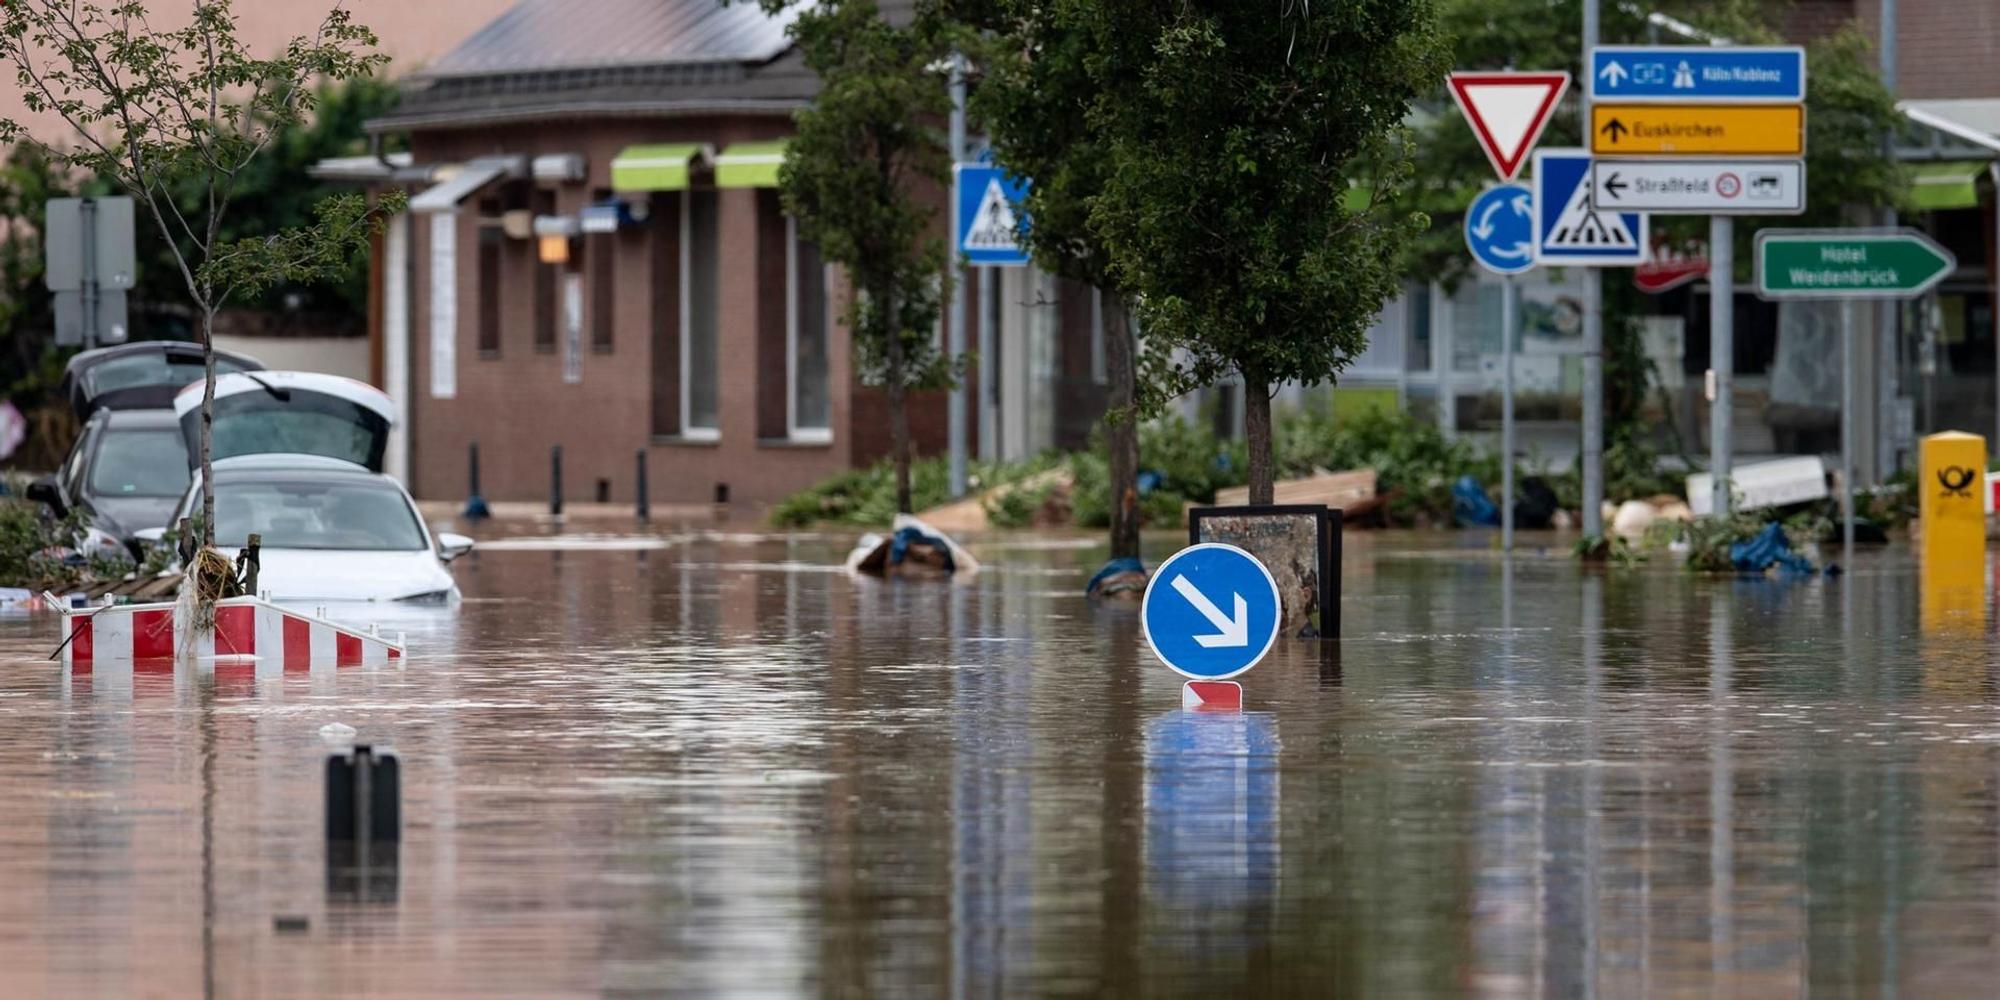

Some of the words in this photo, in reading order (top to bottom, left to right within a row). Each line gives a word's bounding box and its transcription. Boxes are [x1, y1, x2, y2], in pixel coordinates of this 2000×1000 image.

[1633, 121, 1724, 138] Euskirchen
[1635, 177, 1709, 193] Straßfeld
[1822, 246, 1865, 262] Hotel
[1789, 267, 1898, 285] Weidenbrück
